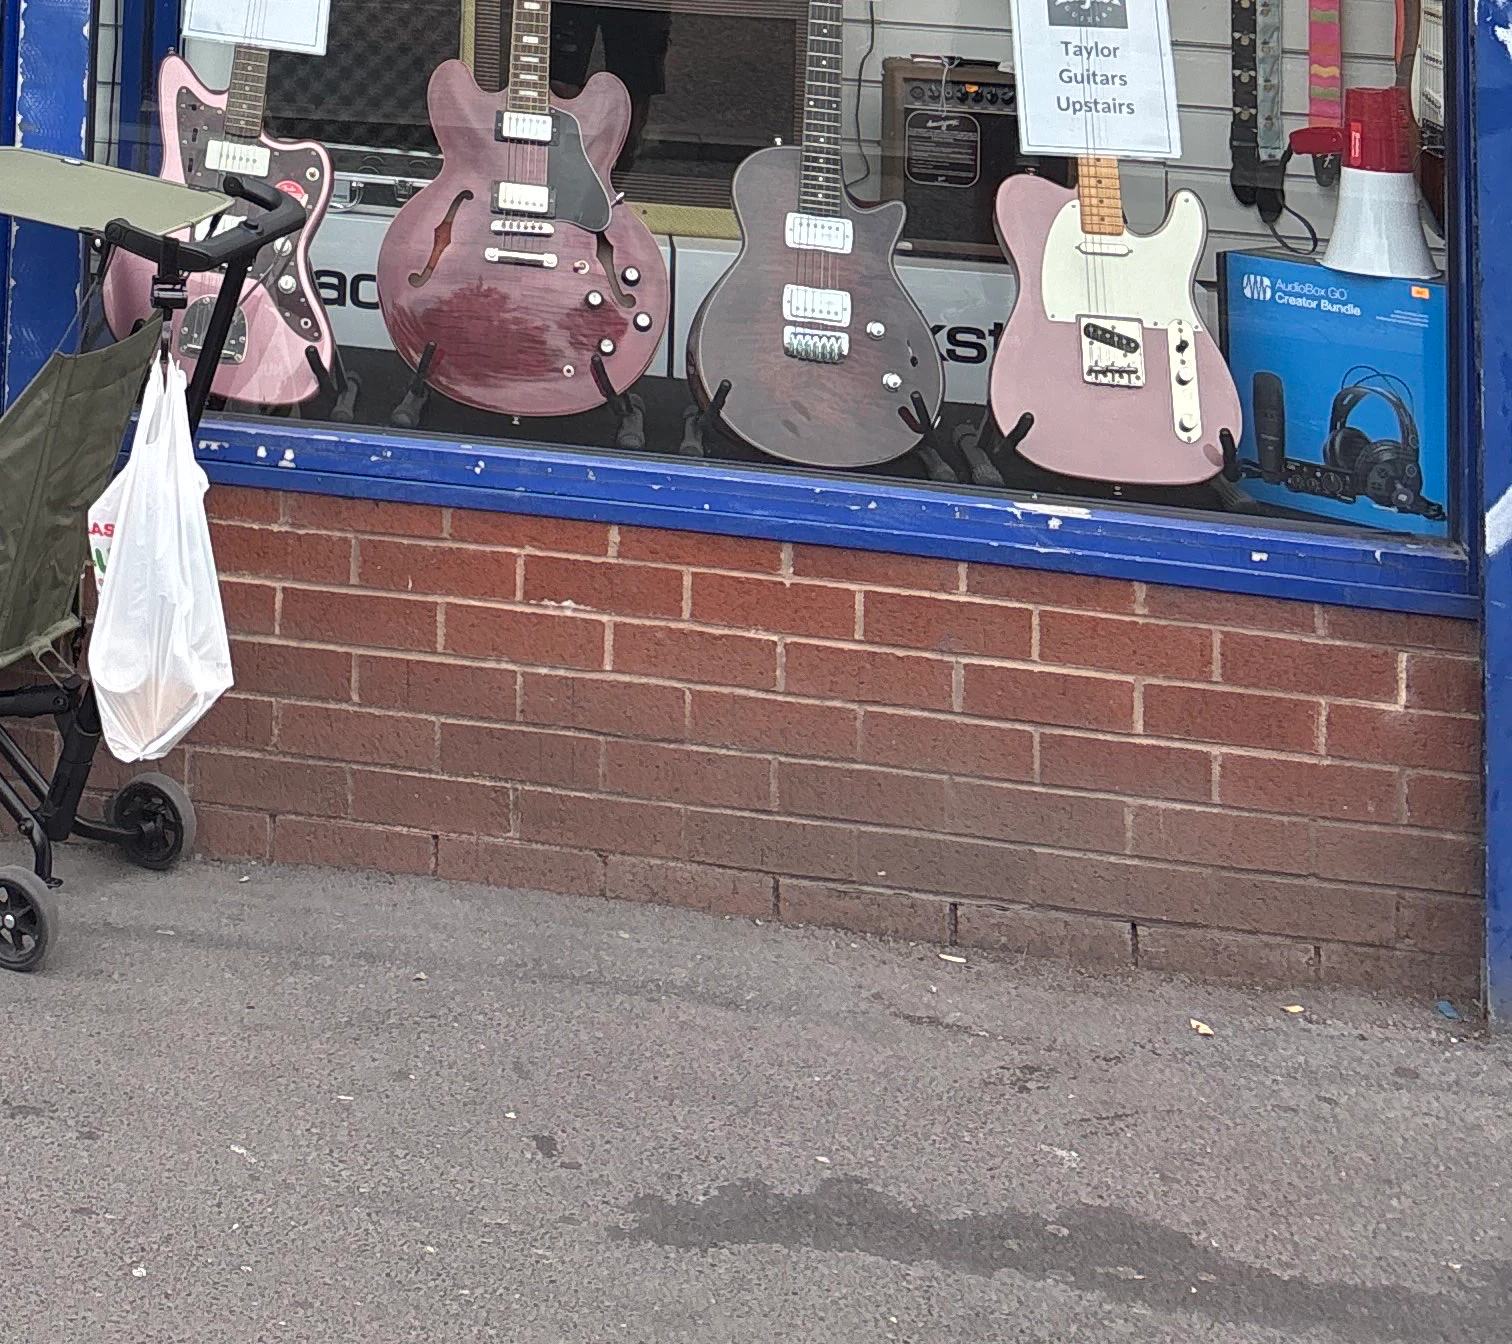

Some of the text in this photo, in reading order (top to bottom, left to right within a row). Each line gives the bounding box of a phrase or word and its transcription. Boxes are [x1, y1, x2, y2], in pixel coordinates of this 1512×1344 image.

[1060, 40, 1121, 61] Taylor
[1058, 68, 1128, 87] Guitars
[1056, 95, 1136, 116] Upstairs
[1275, 279, 1348, 301] AudioBox GO
[1275, 292, 1361, 316] Creator Bundle
